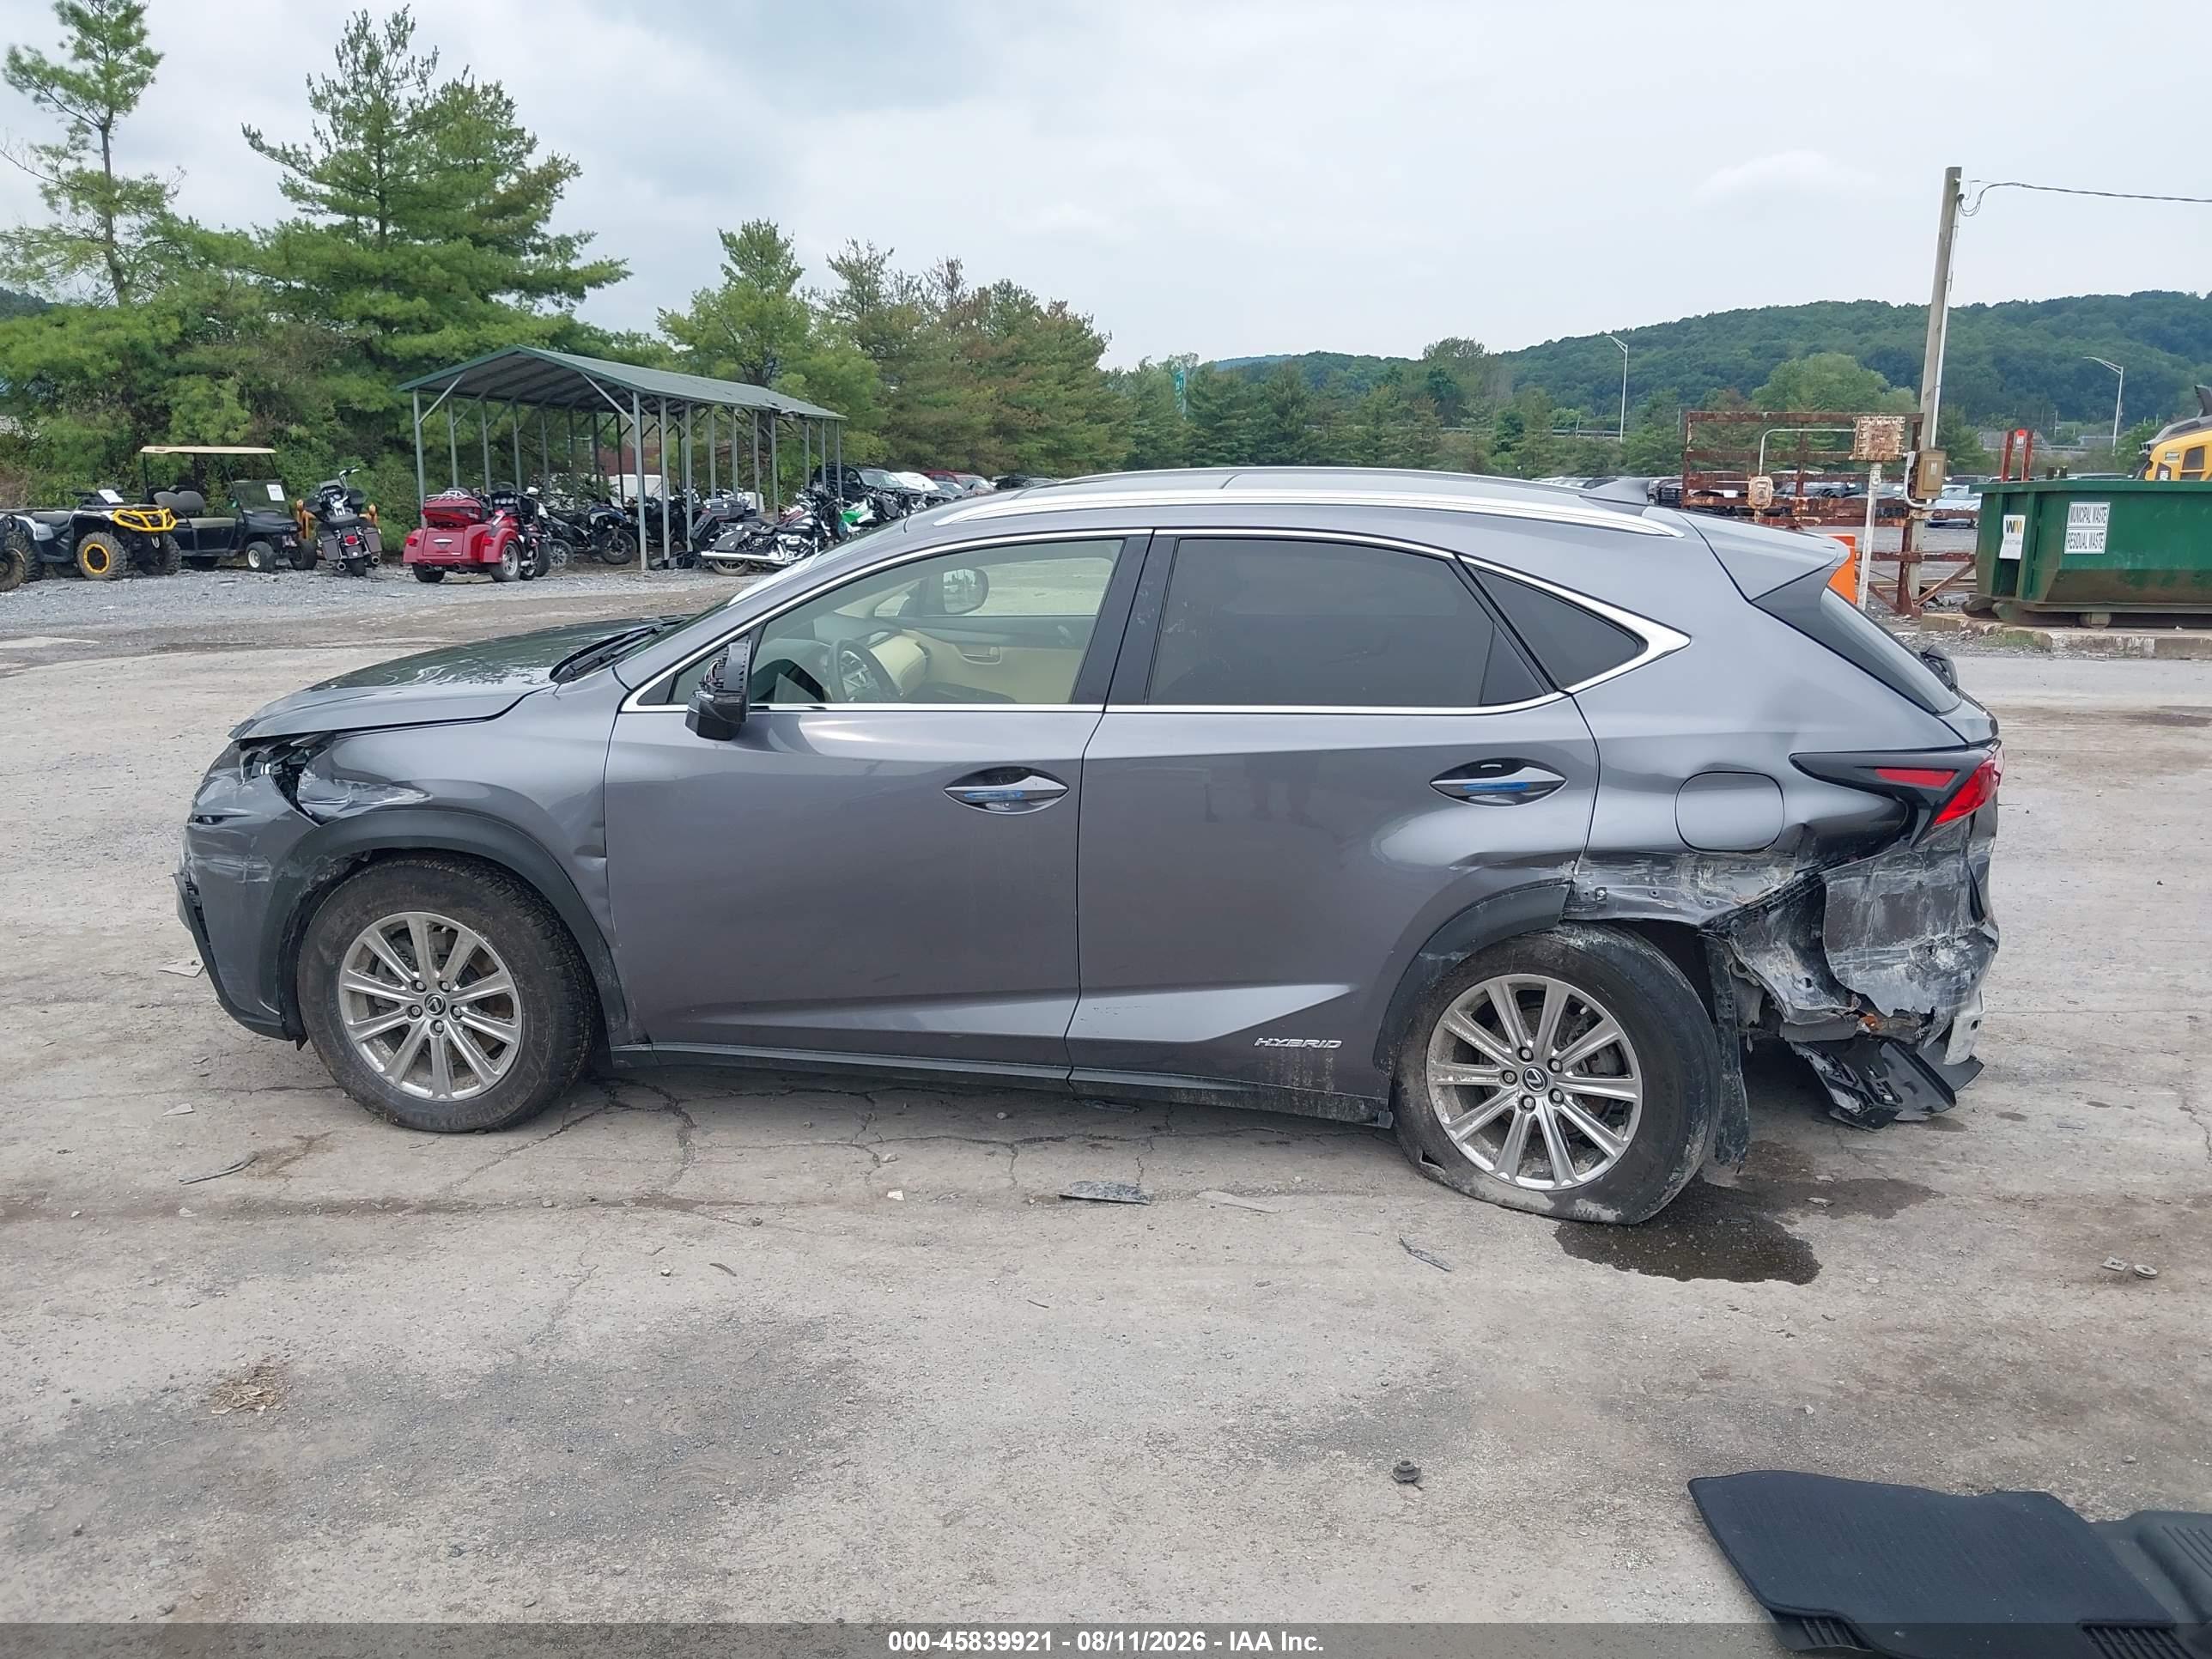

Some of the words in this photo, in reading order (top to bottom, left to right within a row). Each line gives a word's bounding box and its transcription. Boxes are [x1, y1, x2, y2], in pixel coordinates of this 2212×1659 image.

[2092, 506, 2108, 524] WASTE
[2006, 520, 2023, 534] WM
[2067, 532, 2087, 550] RESIDUAL
[2088, 532, 2105, 550] WASTE
[1255, 1037, 1342, 1048] HYBRID
